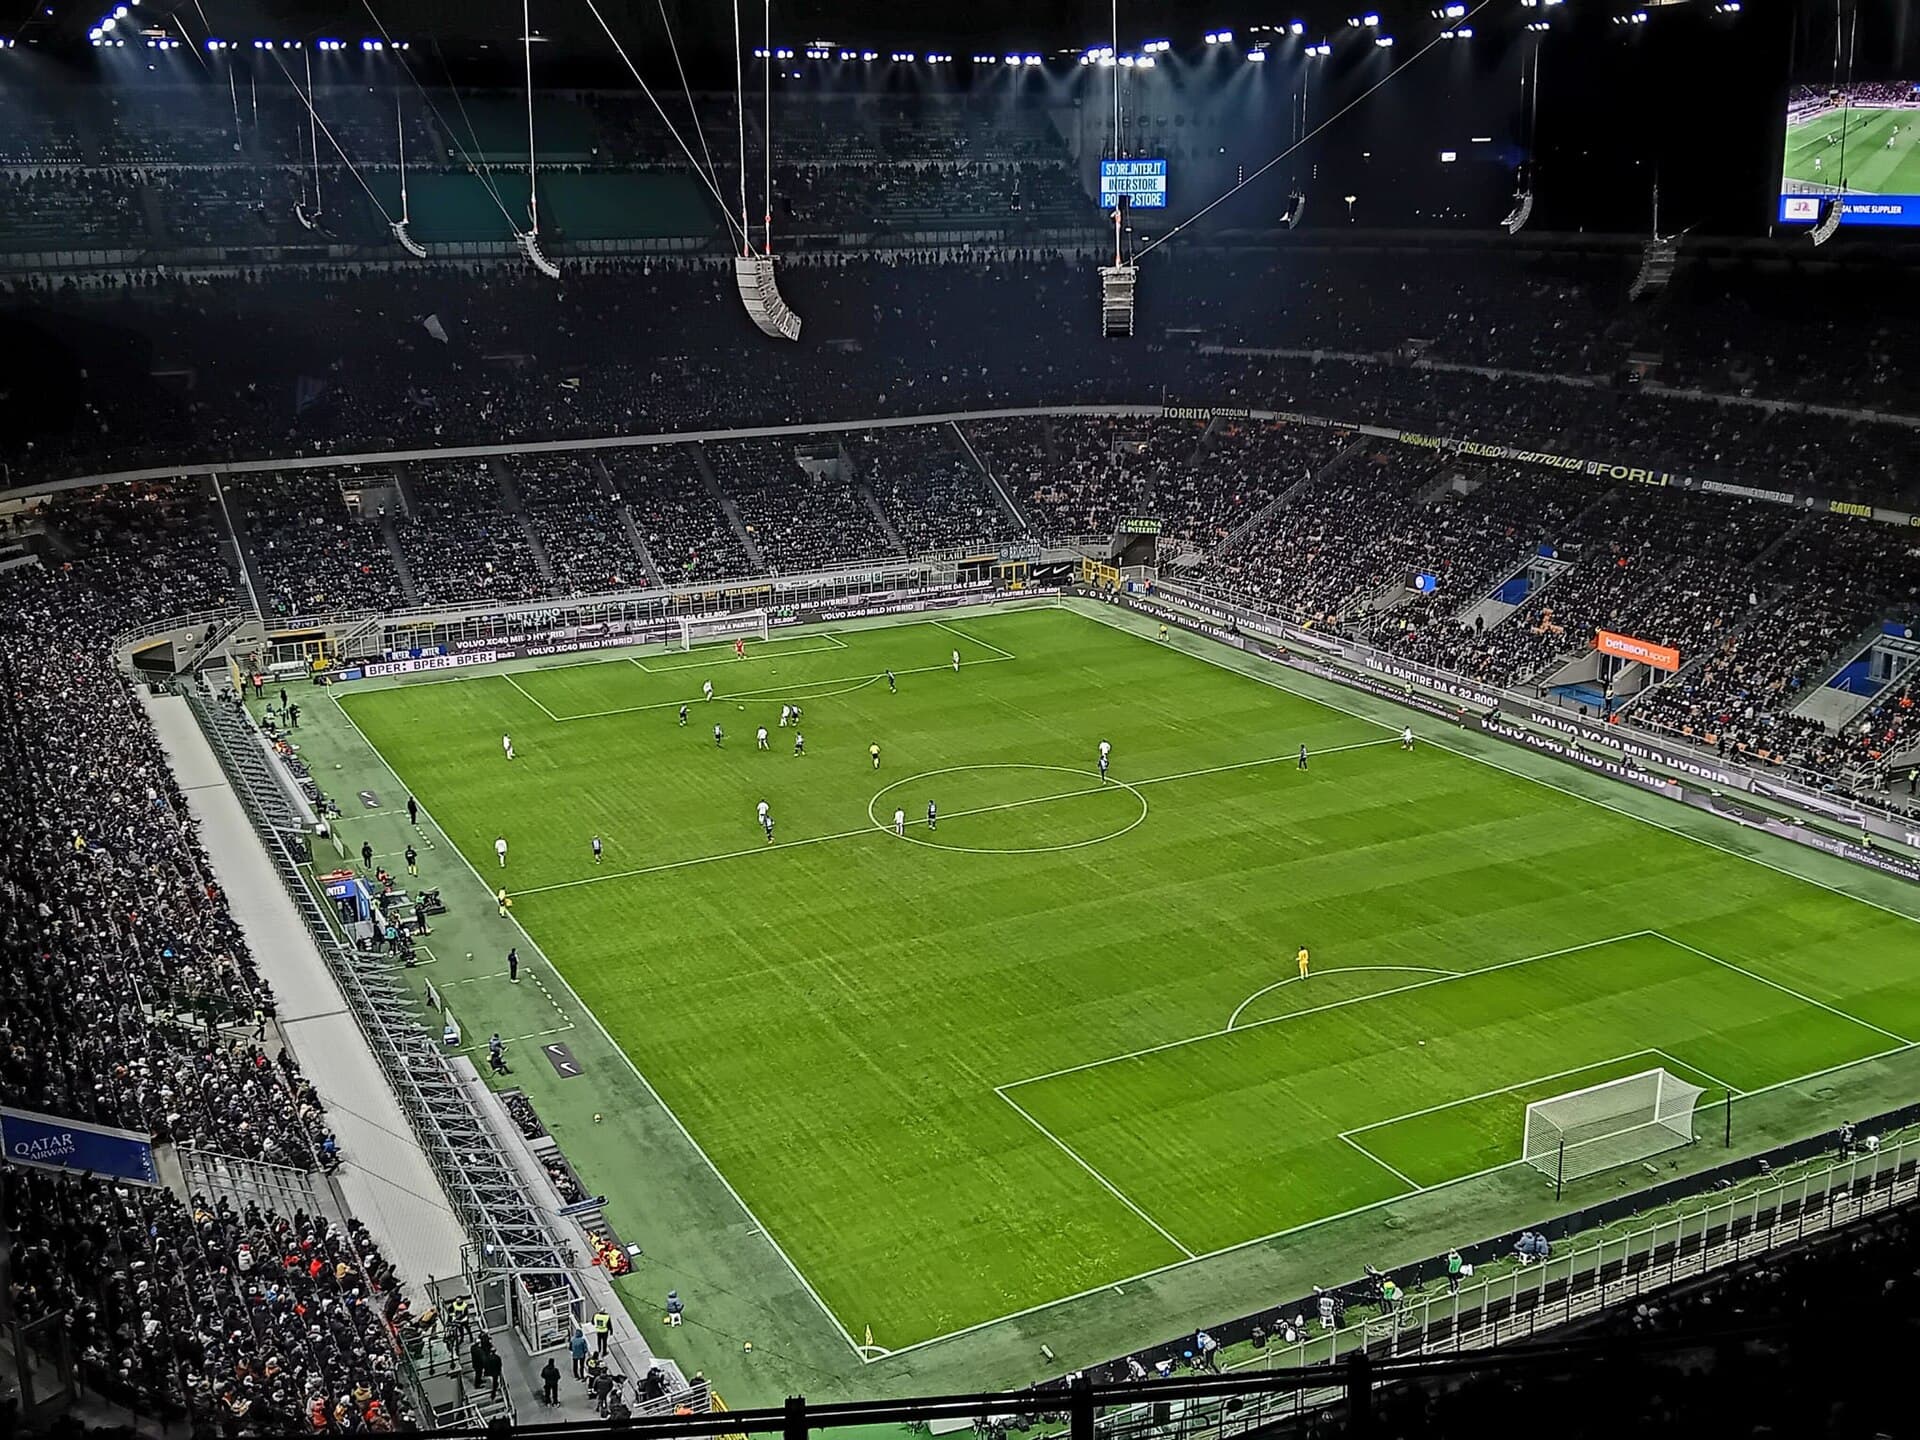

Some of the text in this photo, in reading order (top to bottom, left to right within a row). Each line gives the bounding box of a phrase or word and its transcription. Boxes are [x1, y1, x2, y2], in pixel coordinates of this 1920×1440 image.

[1108, 178, 1158, 191] INTER STORE
[1136, 194, 1162, 206] STORE
[1853, 204, 1870, 214] WINE
[1871, 204, 1902, 214] SUPPLIER
[1163, 408, 1210, 420] TORRITA
[1458, 441, 1502, 458] CISLAGO
[1517, 450, 1584, 470] CATTOLICA
[1830, 501, 1872, 518] SAVONA
[820, 597, 848, 607] HYBRID
[886, 604, 913, 613] HYBRID
[508, 608, 560, 621] NETTUNO
[456, 639, 485, 649] VOLVO
[486, 636, 508, 645] XC40
[527, 637, 632, 655] VOLVO XC40 MILD HYBRID
[370, 662, 406, 675] BPER:
[414, 658, 450, 670] BPER:
[457, 653, 492, 665] BPER:
[1365, 658, 1383, 671] TUA
[1384, 664, 1391, 673] A
[1393, 668, 1432, 688] PARTIRE
[1434, 680, 1448, 692] DA
[1449, 686, 1457, 695] €
[15, 1133, 73, 1156] QATAR
[30, 1146, 76, 1160] AIRWAYS
